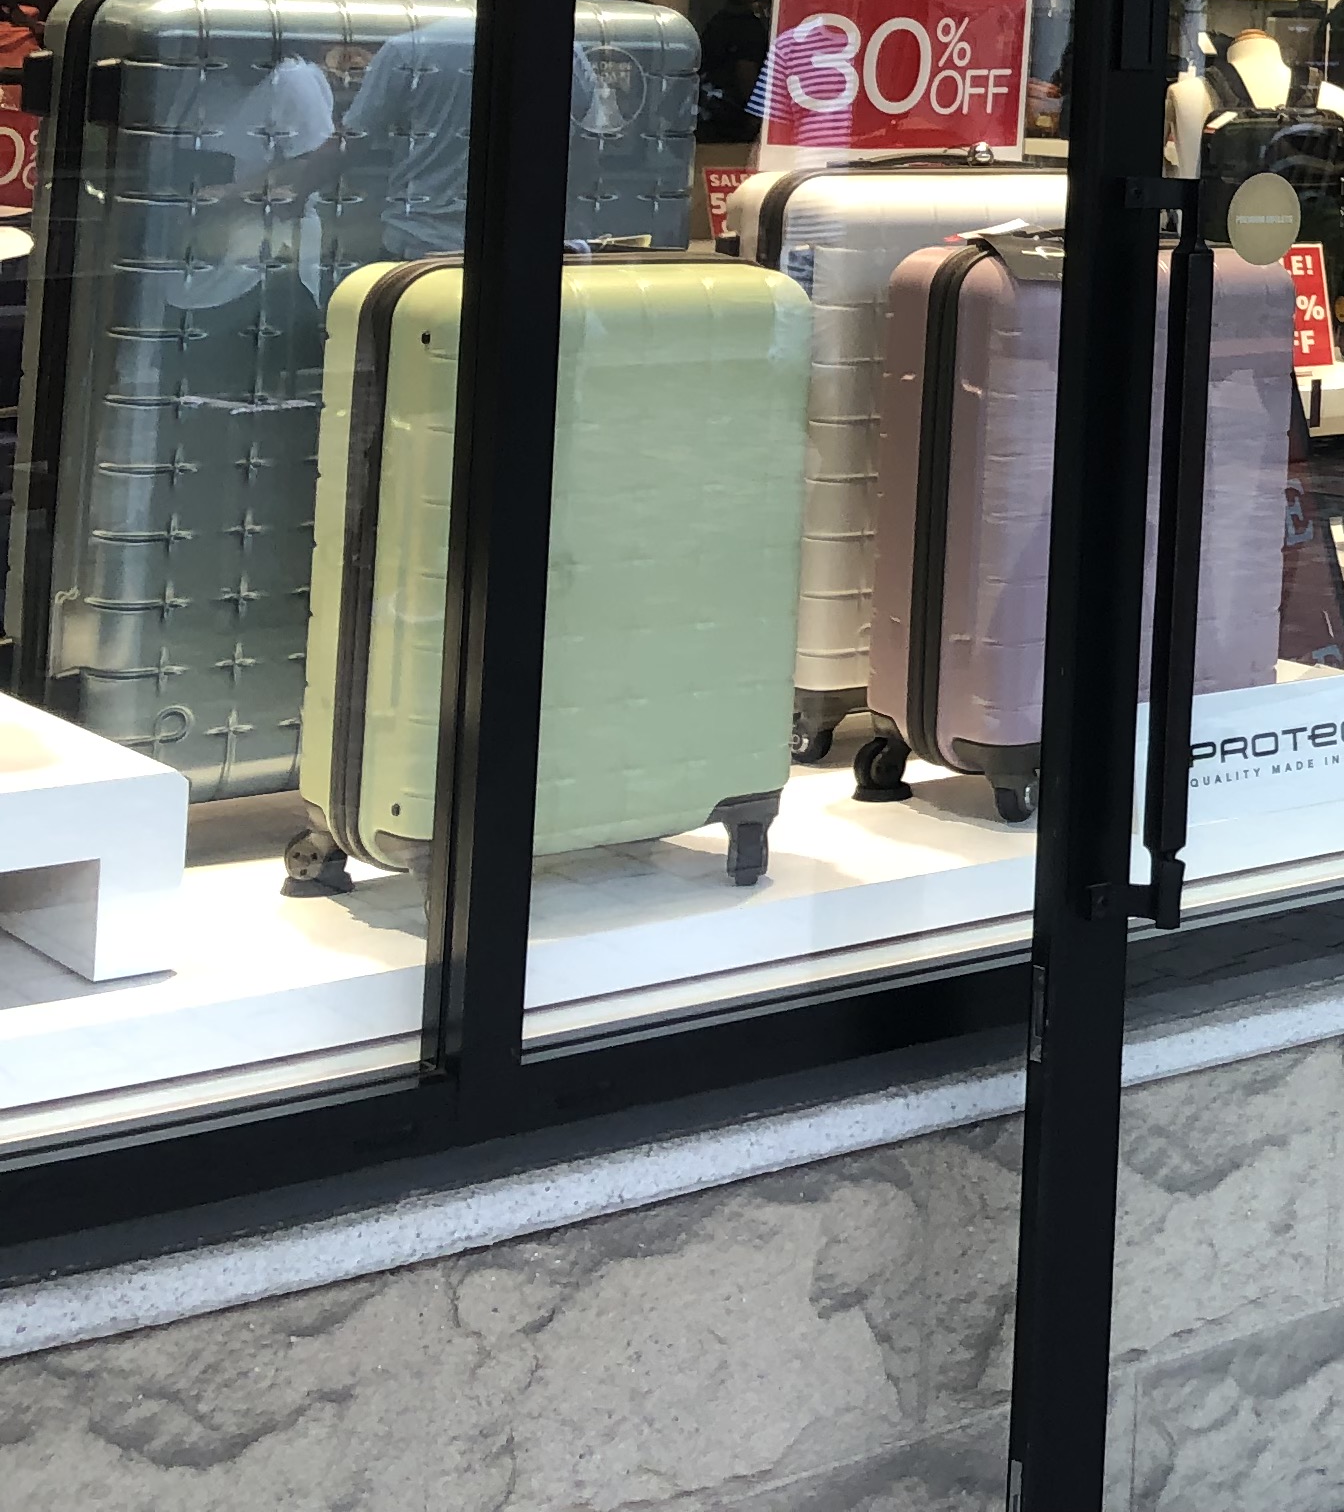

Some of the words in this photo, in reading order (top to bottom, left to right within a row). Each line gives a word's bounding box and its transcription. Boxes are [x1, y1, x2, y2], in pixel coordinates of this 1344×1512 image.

[786, 12, 972, 115] 30%
[930, 69, 1013, 115] OFF
[1190, 768, 1261, 788] QUALITY
[1272, 758, 1315, 775] MADE
[1324, 754, 1340, 766] IN
